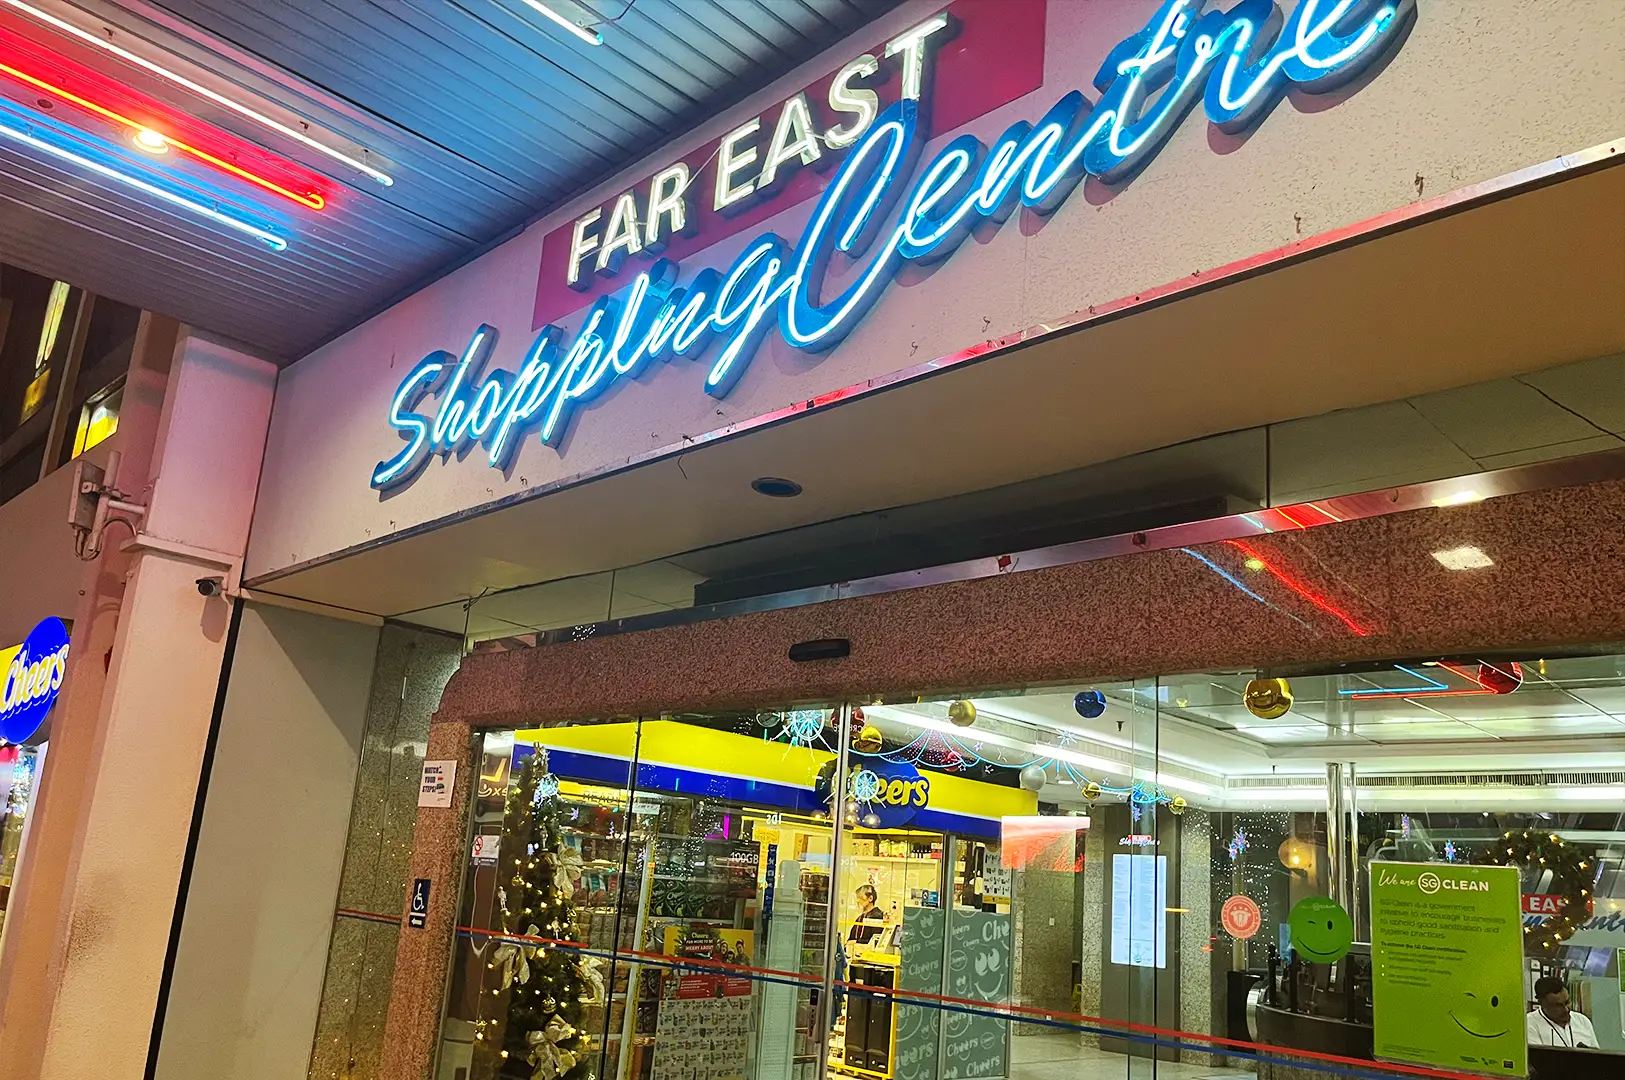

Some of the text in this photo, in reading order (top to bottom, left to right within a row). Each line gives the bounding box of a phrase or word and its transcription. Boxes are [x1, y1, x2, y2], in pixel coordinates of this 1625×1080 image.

[566, 12, 950, 288] FAR EAST
[370, 0, 1416, 490] Shopping Centre
[0, 643, 70, 714] Cheers
[1379, 868, 1398, 887] We
[1399, 879, 1416, 887] are
[1442, 879, 1490, 892] CLEAN
[908, 960, 939, 976] Cheers
[946, 1038, 979, 1057] Cheers
[966, 1055, 1001, 1077] Cheers
